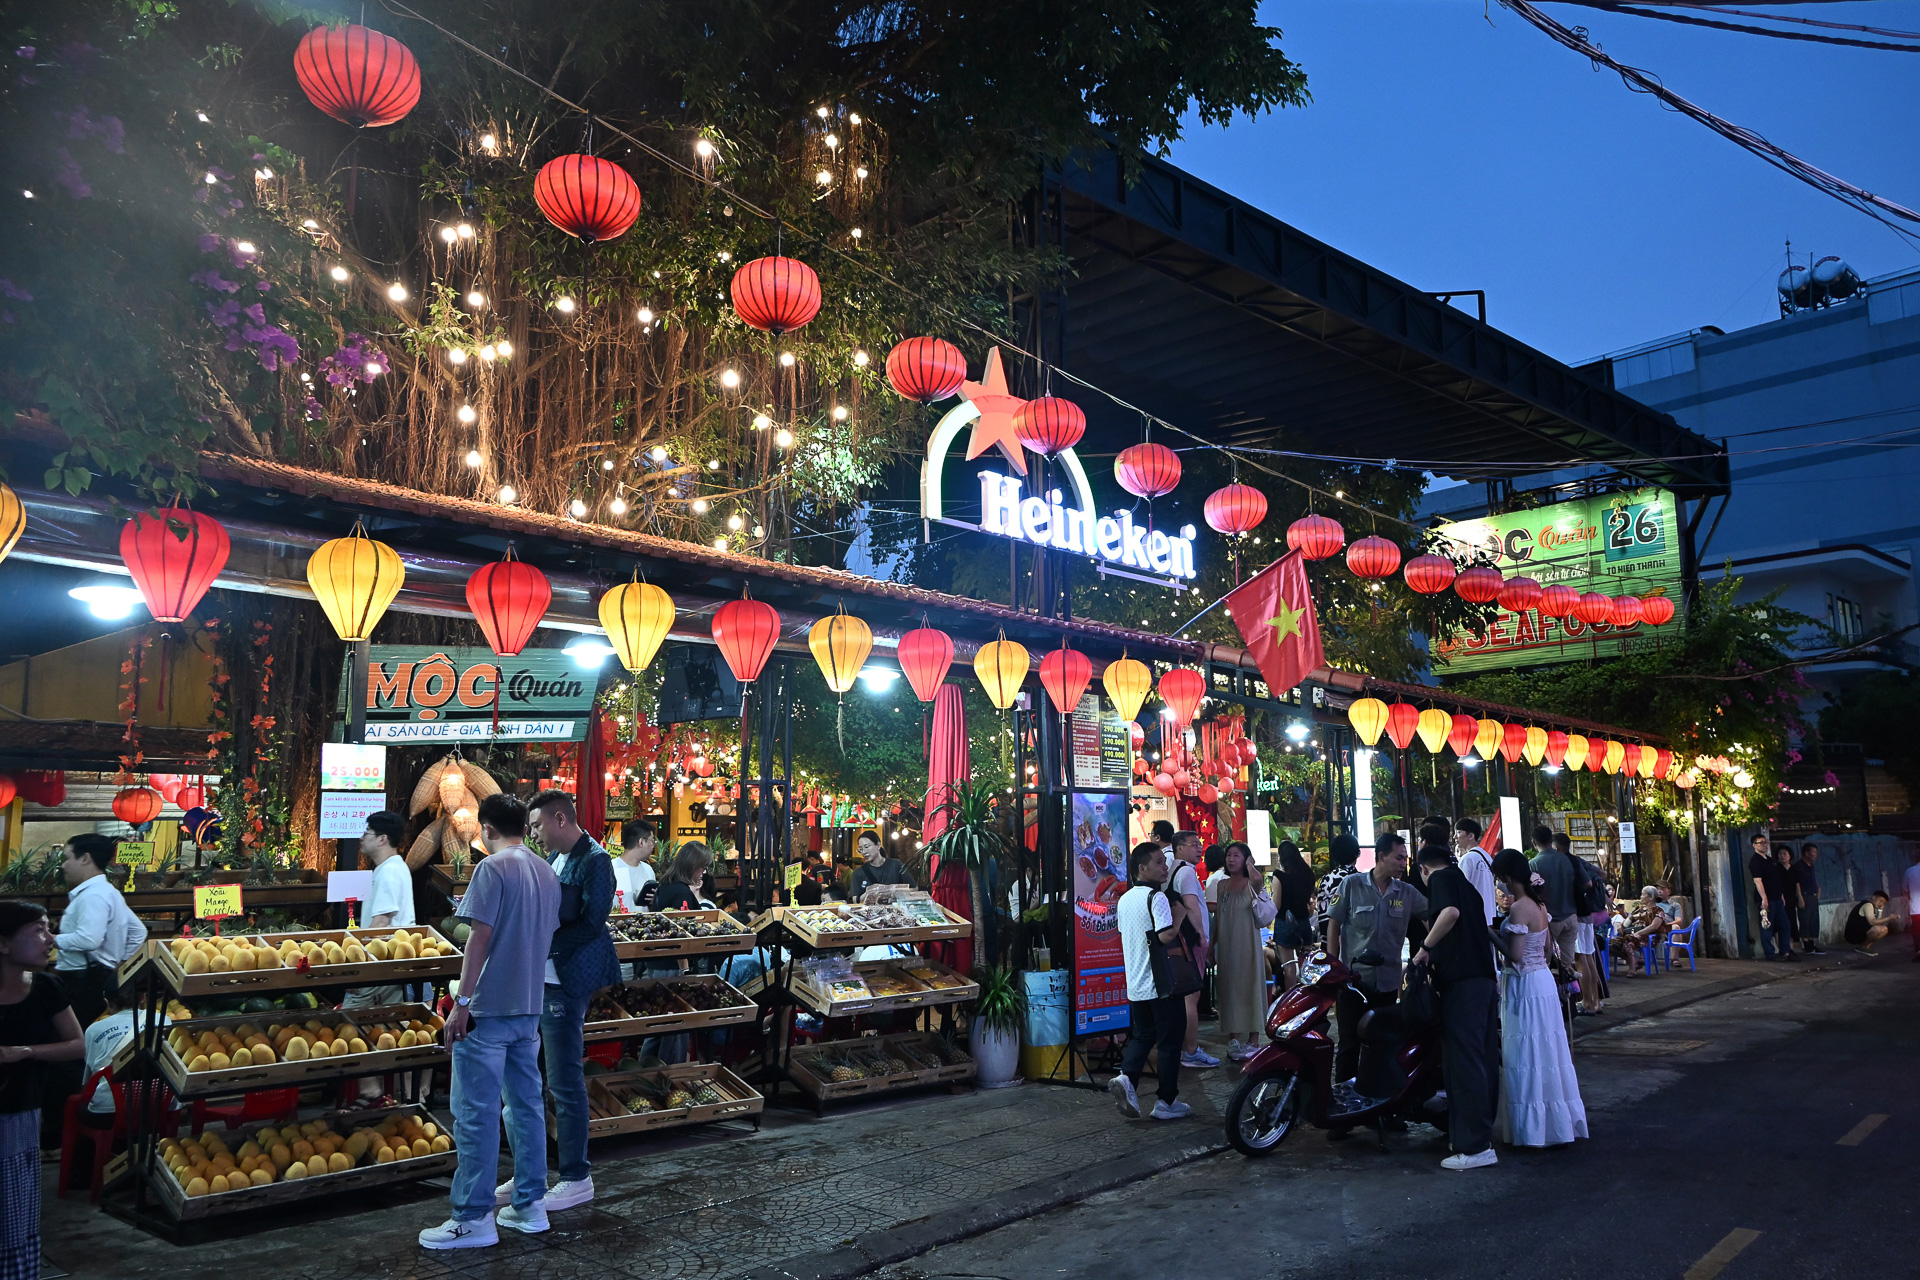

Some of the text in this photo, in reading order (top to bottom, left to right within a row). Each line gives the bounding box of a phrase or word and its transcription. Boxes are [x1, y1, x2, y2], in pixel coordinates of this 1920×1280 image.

[977, 470, 1197, 579] Heineken
[1538, 519, 1599, 551] Quán
[1608, 507, 1660, 550] 26
[366, 652, 586, 721] MỘC Quán
[365, 724, 382, 737] ẢI
[422, 722, 450, 736] QUÊ
[486, 723, 521, 736] BNH
[524, 721, 554, 736] DÂN
[330, 766, 380, 777] 25.000
[205, 898, 229, 907] Mango
[1080, 914, 1092, 930] Số
[1091, 919, 1097, 932] 1
